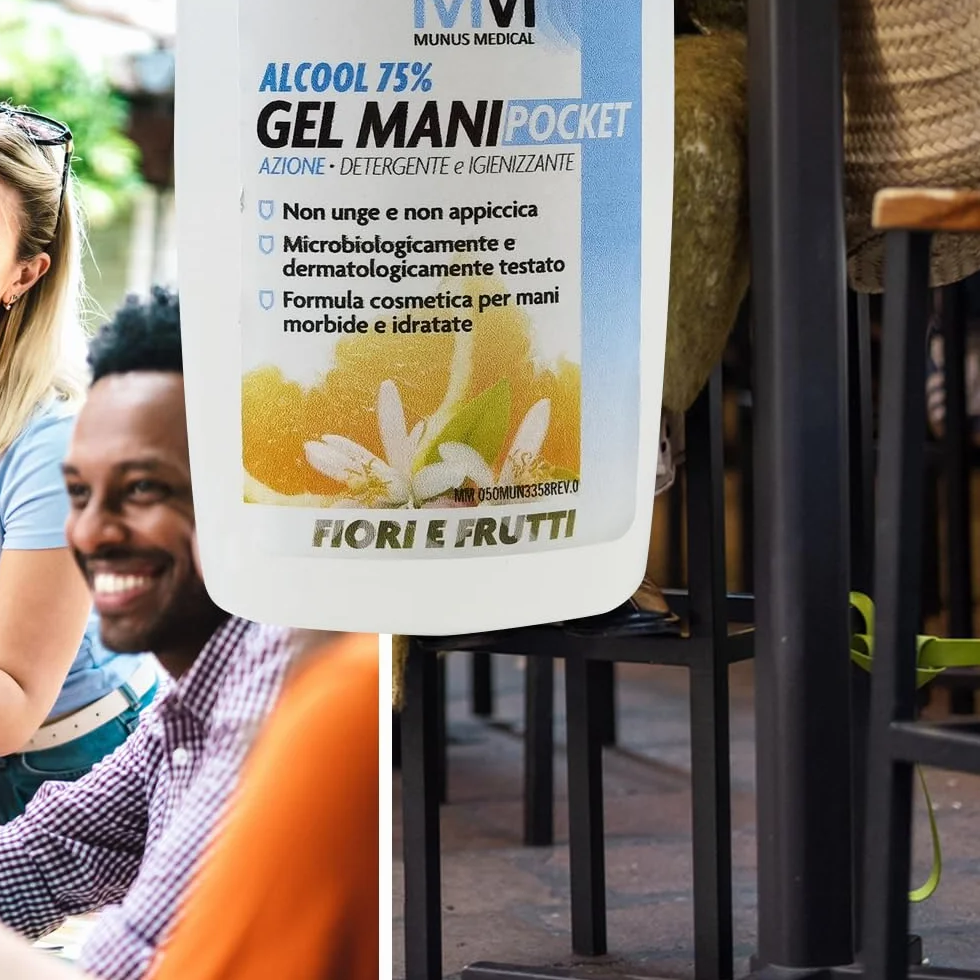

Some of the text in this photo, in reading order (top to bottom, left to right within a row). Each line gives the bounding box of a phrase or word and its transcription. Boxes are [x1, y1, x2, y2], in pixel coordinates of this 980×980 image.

[414, 32, 535, 46] MUNUS MEDICAL
[259, 62, 433, 92] ALCOOL 75%
[256, 100, 632, 149] GEL MANI POCKET
[258, 153, 576, 175] AZIONE DETERGENTE e IGIENIZZANTE
[283, 200, 539, 226] Non unge e non appiccica
[283, 234, 517, 259] Microbiologicamente e
[282, 257, 566, 283] dermatologicamente testato
[283, 285, 560, 313] Formula cosmetica per mani
[283, 313, 473, 334] morbide e idratate
[311, 508, 577, 550] FIORI E FRUTTI
